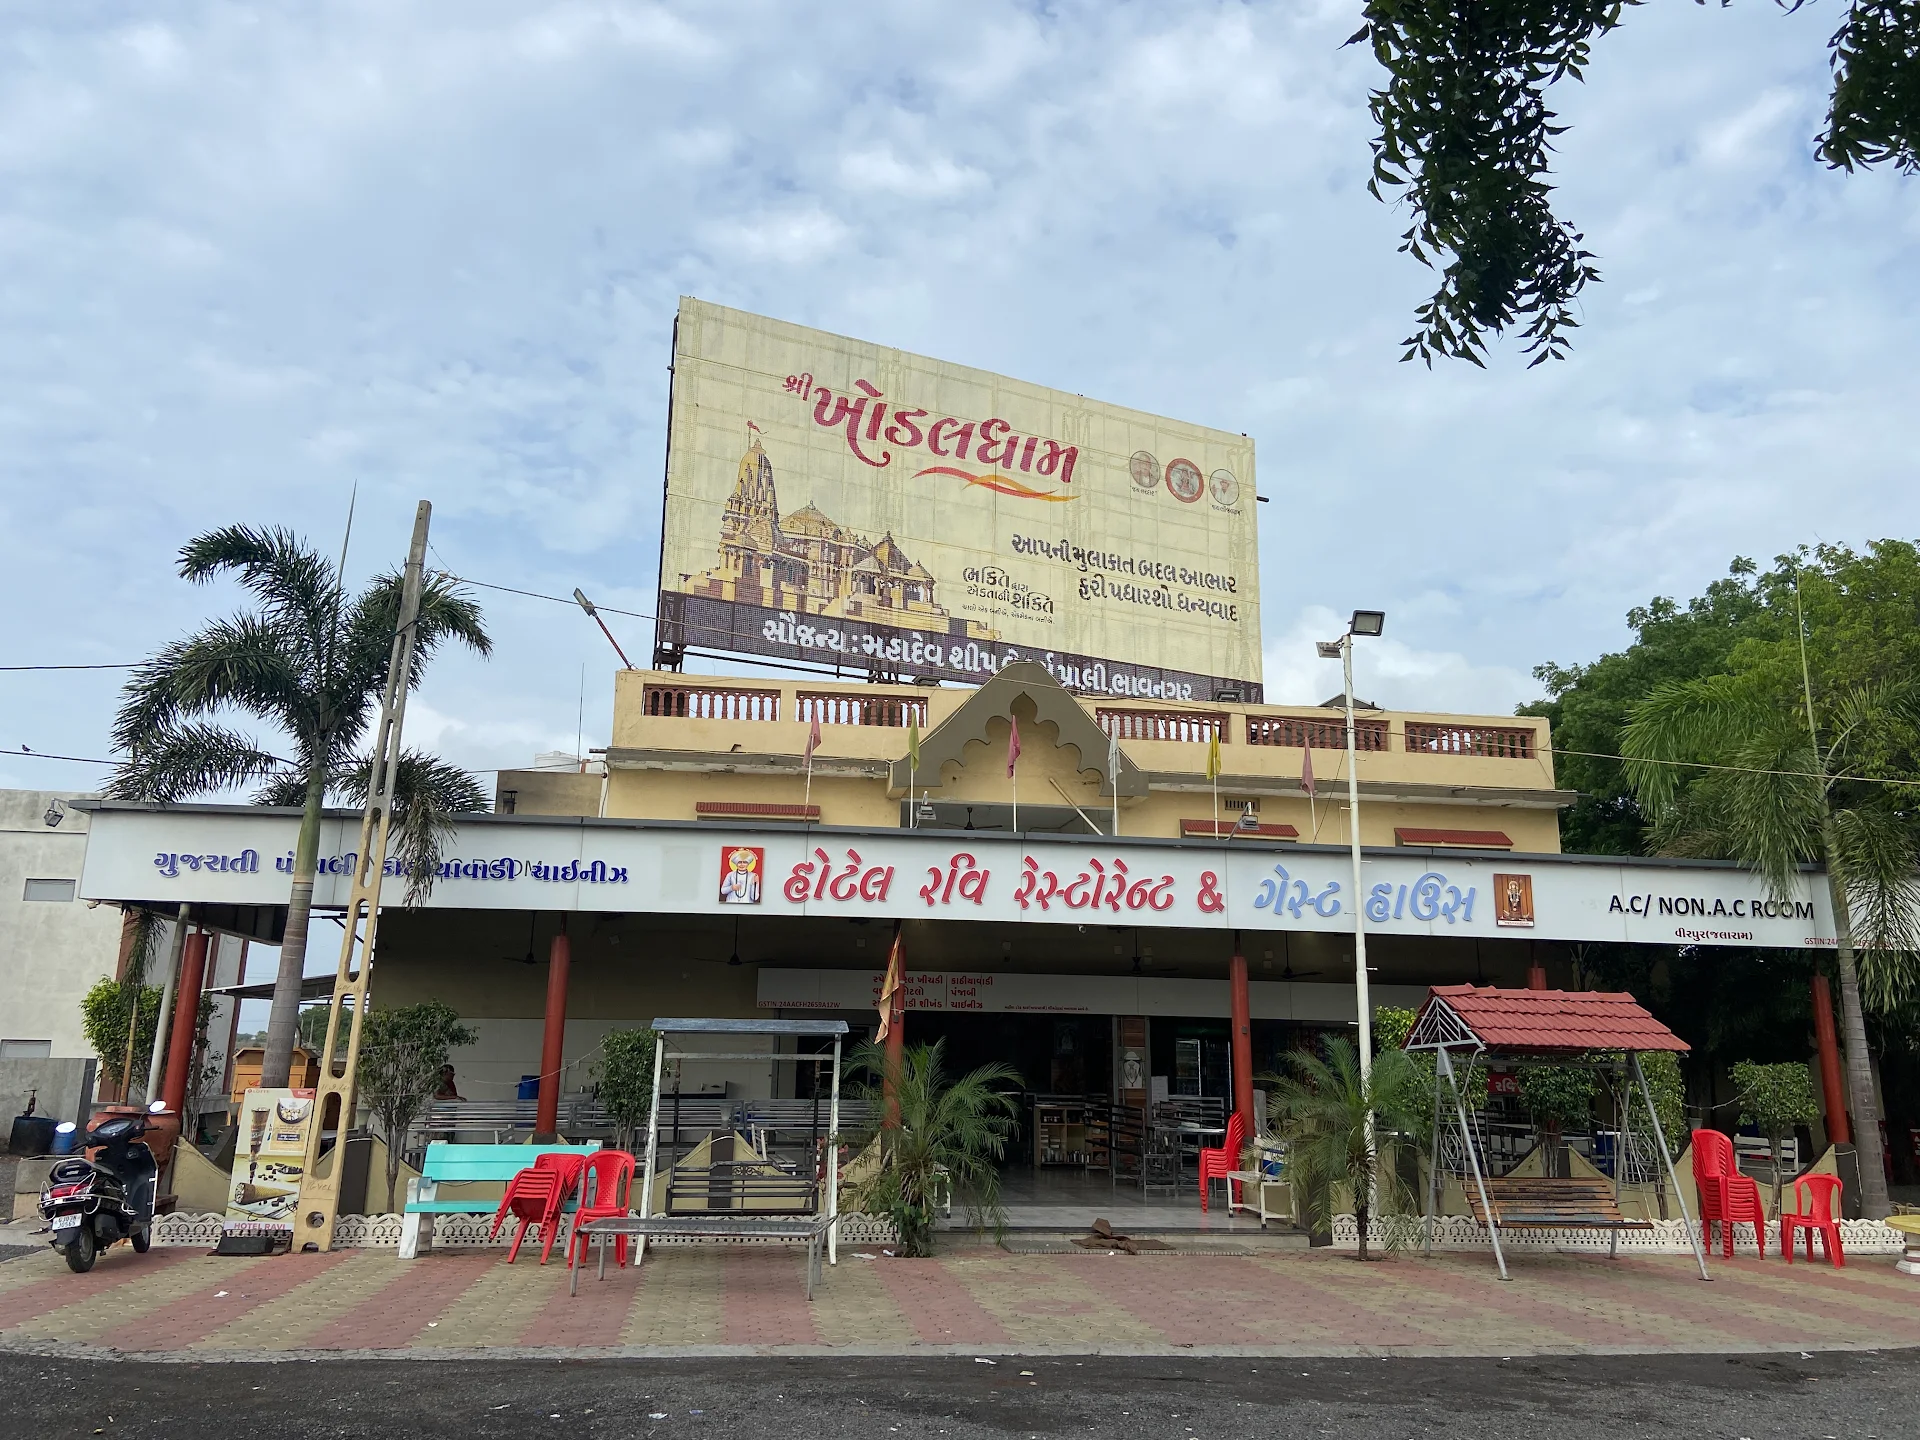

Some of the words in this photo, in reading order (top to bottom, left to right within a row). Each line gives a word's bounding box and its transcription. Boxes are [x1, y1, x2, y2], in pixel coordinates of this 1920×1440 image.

[781, 372, 813, 401] શ્રી
[813, 379, 1079, 483] ખોડલધામ
[1011, 533, 1070, 562] આપની
[1072, 546, 1134, 575] મુલાકાત
[1138, 558, 1176, 583] બદલ
[1179, 567, 1237, 594] આભાર
[862, 632, 944, 667] મહાદેવ
[153, 849, 260, 878] ગુજરાતી
[783, 847, 895, 904] હોટેલ
[919, 853, 990, 907] રવિ
[1197, 870, 1226, 914] &
[1254, 864, 1341, 919] ગેસ્ટ
[1365, 872, 1476, 924] હાઉસ
[1608, 894, 1651, 918] A.C/
[1751, 900, 1815, 920] ROOM
[917, 975, 943, 984] ખીચડી
[951, 975, 993, 985] કાઠીયાવાડી
[951, 988, 976, 997] પંજાબી
[234, 1222, 265, 1230] HOTEL
[265, 1223, 286, 1231] RAVI
